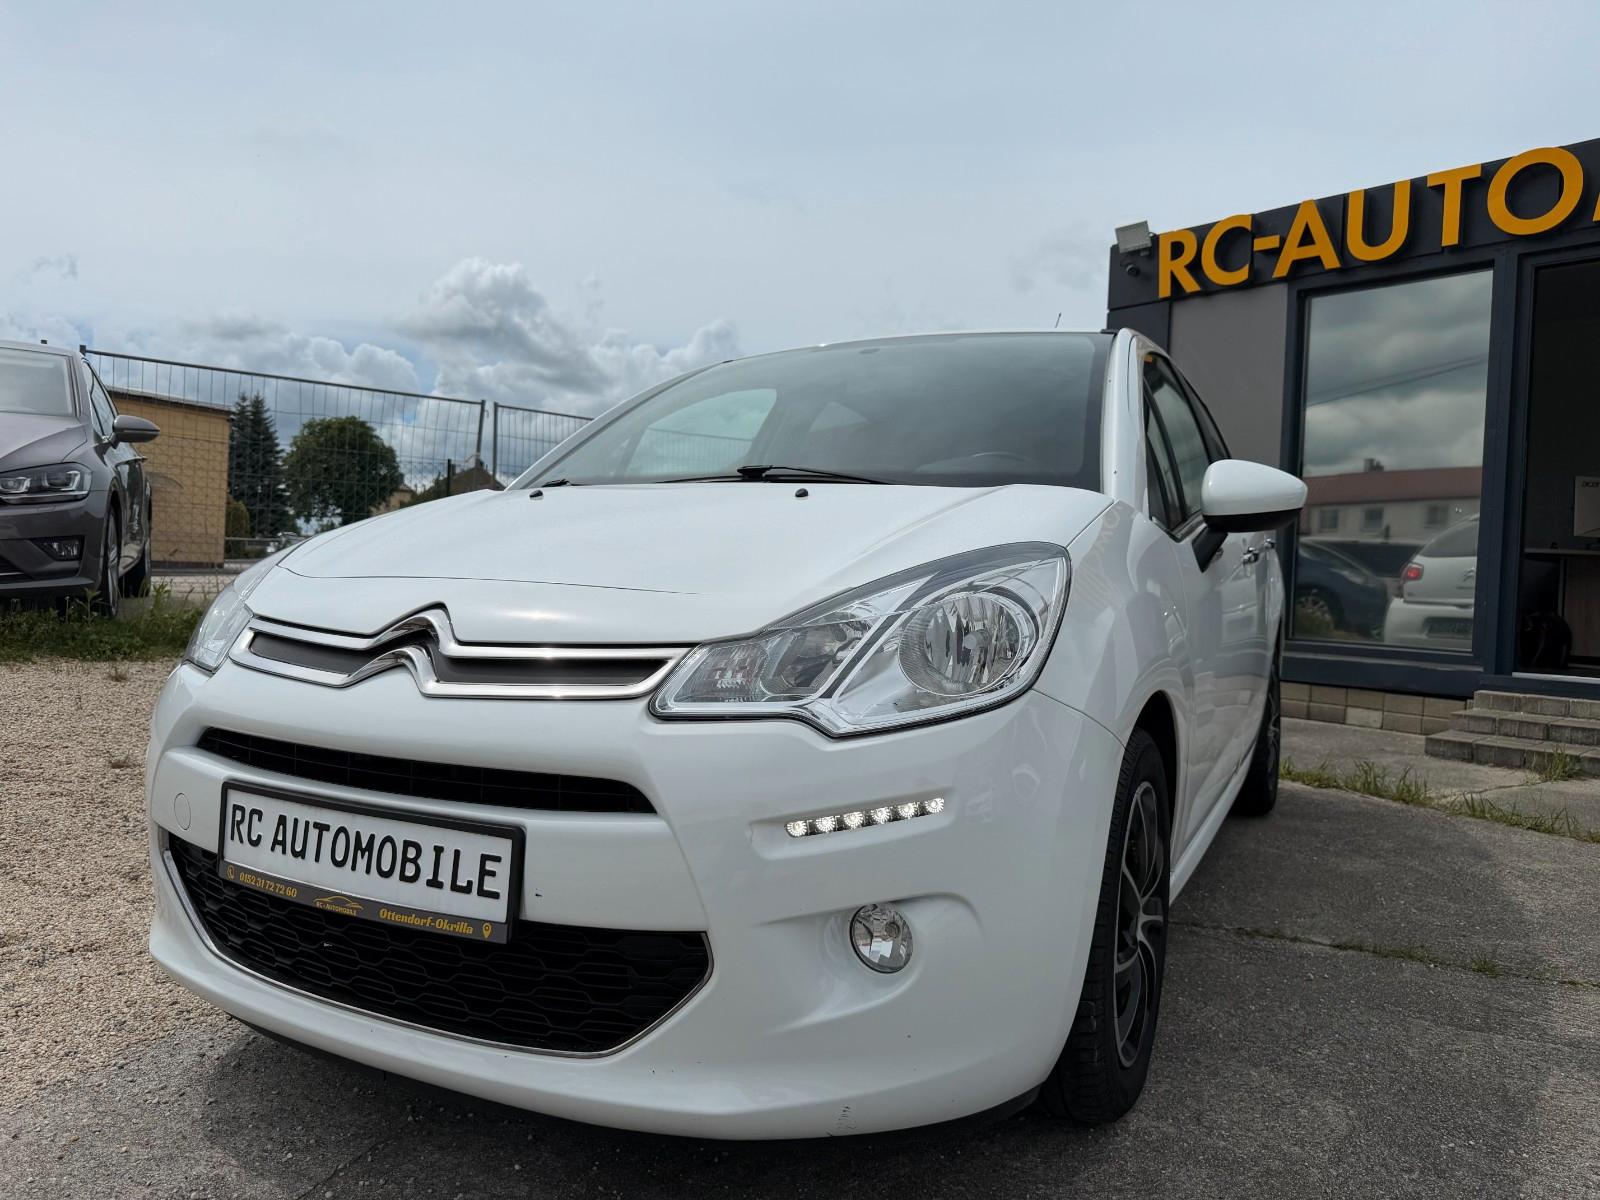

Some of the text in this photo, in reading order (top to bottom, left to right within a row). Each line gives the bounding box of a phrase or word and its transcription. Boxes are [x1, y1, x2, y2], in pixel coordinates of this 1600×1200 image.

[1158, 146, 1600, 299] RC-AUTO
[230, 803, 502, 900] RC AUTOMOBILE
[379, 908, 474, 934] Ottendorf-Okrilla
